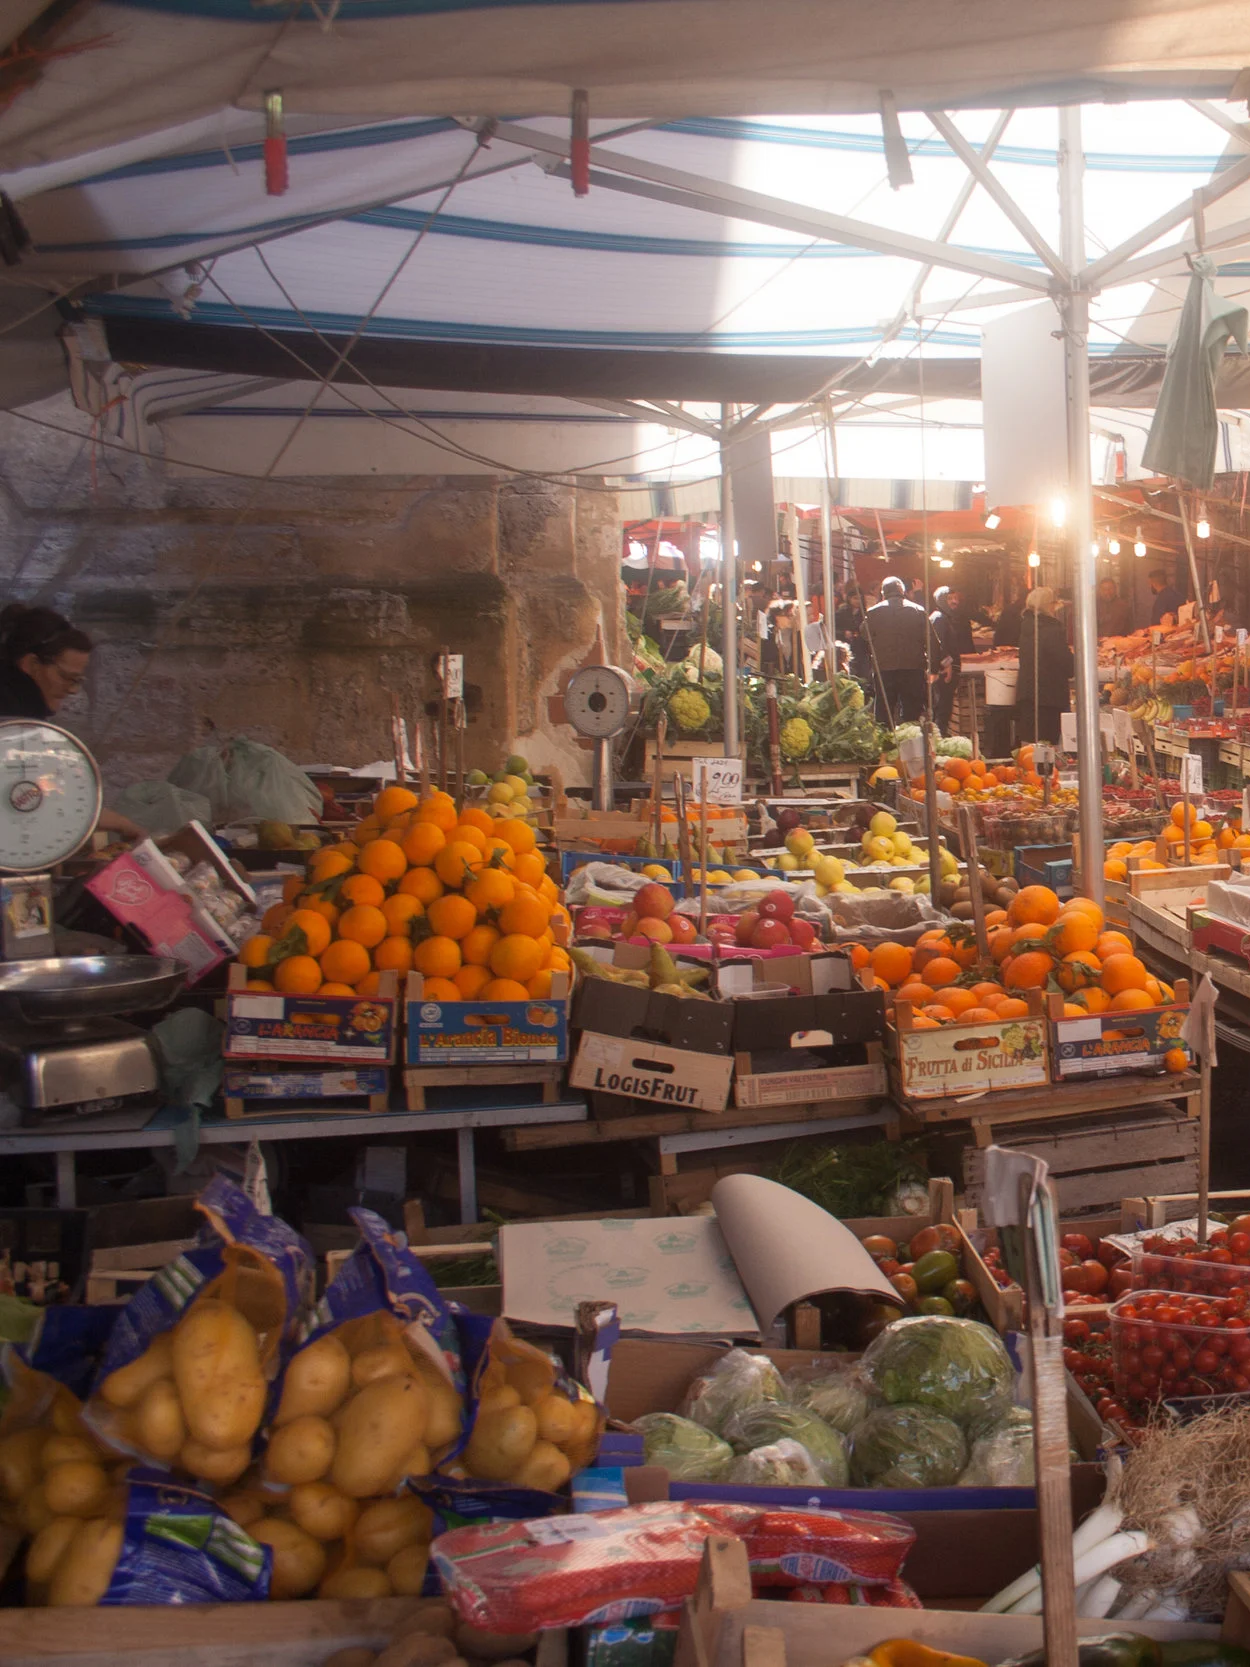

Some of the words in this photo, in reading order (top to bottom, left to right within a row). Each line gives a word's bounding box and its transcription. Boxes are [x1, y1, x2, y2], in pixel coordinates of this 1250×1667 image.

[419, 1027, 497, 1048] L'Arancia
[502, 1027, 558, 1047] Bionda
[961, 1057, 973, 1072] di
